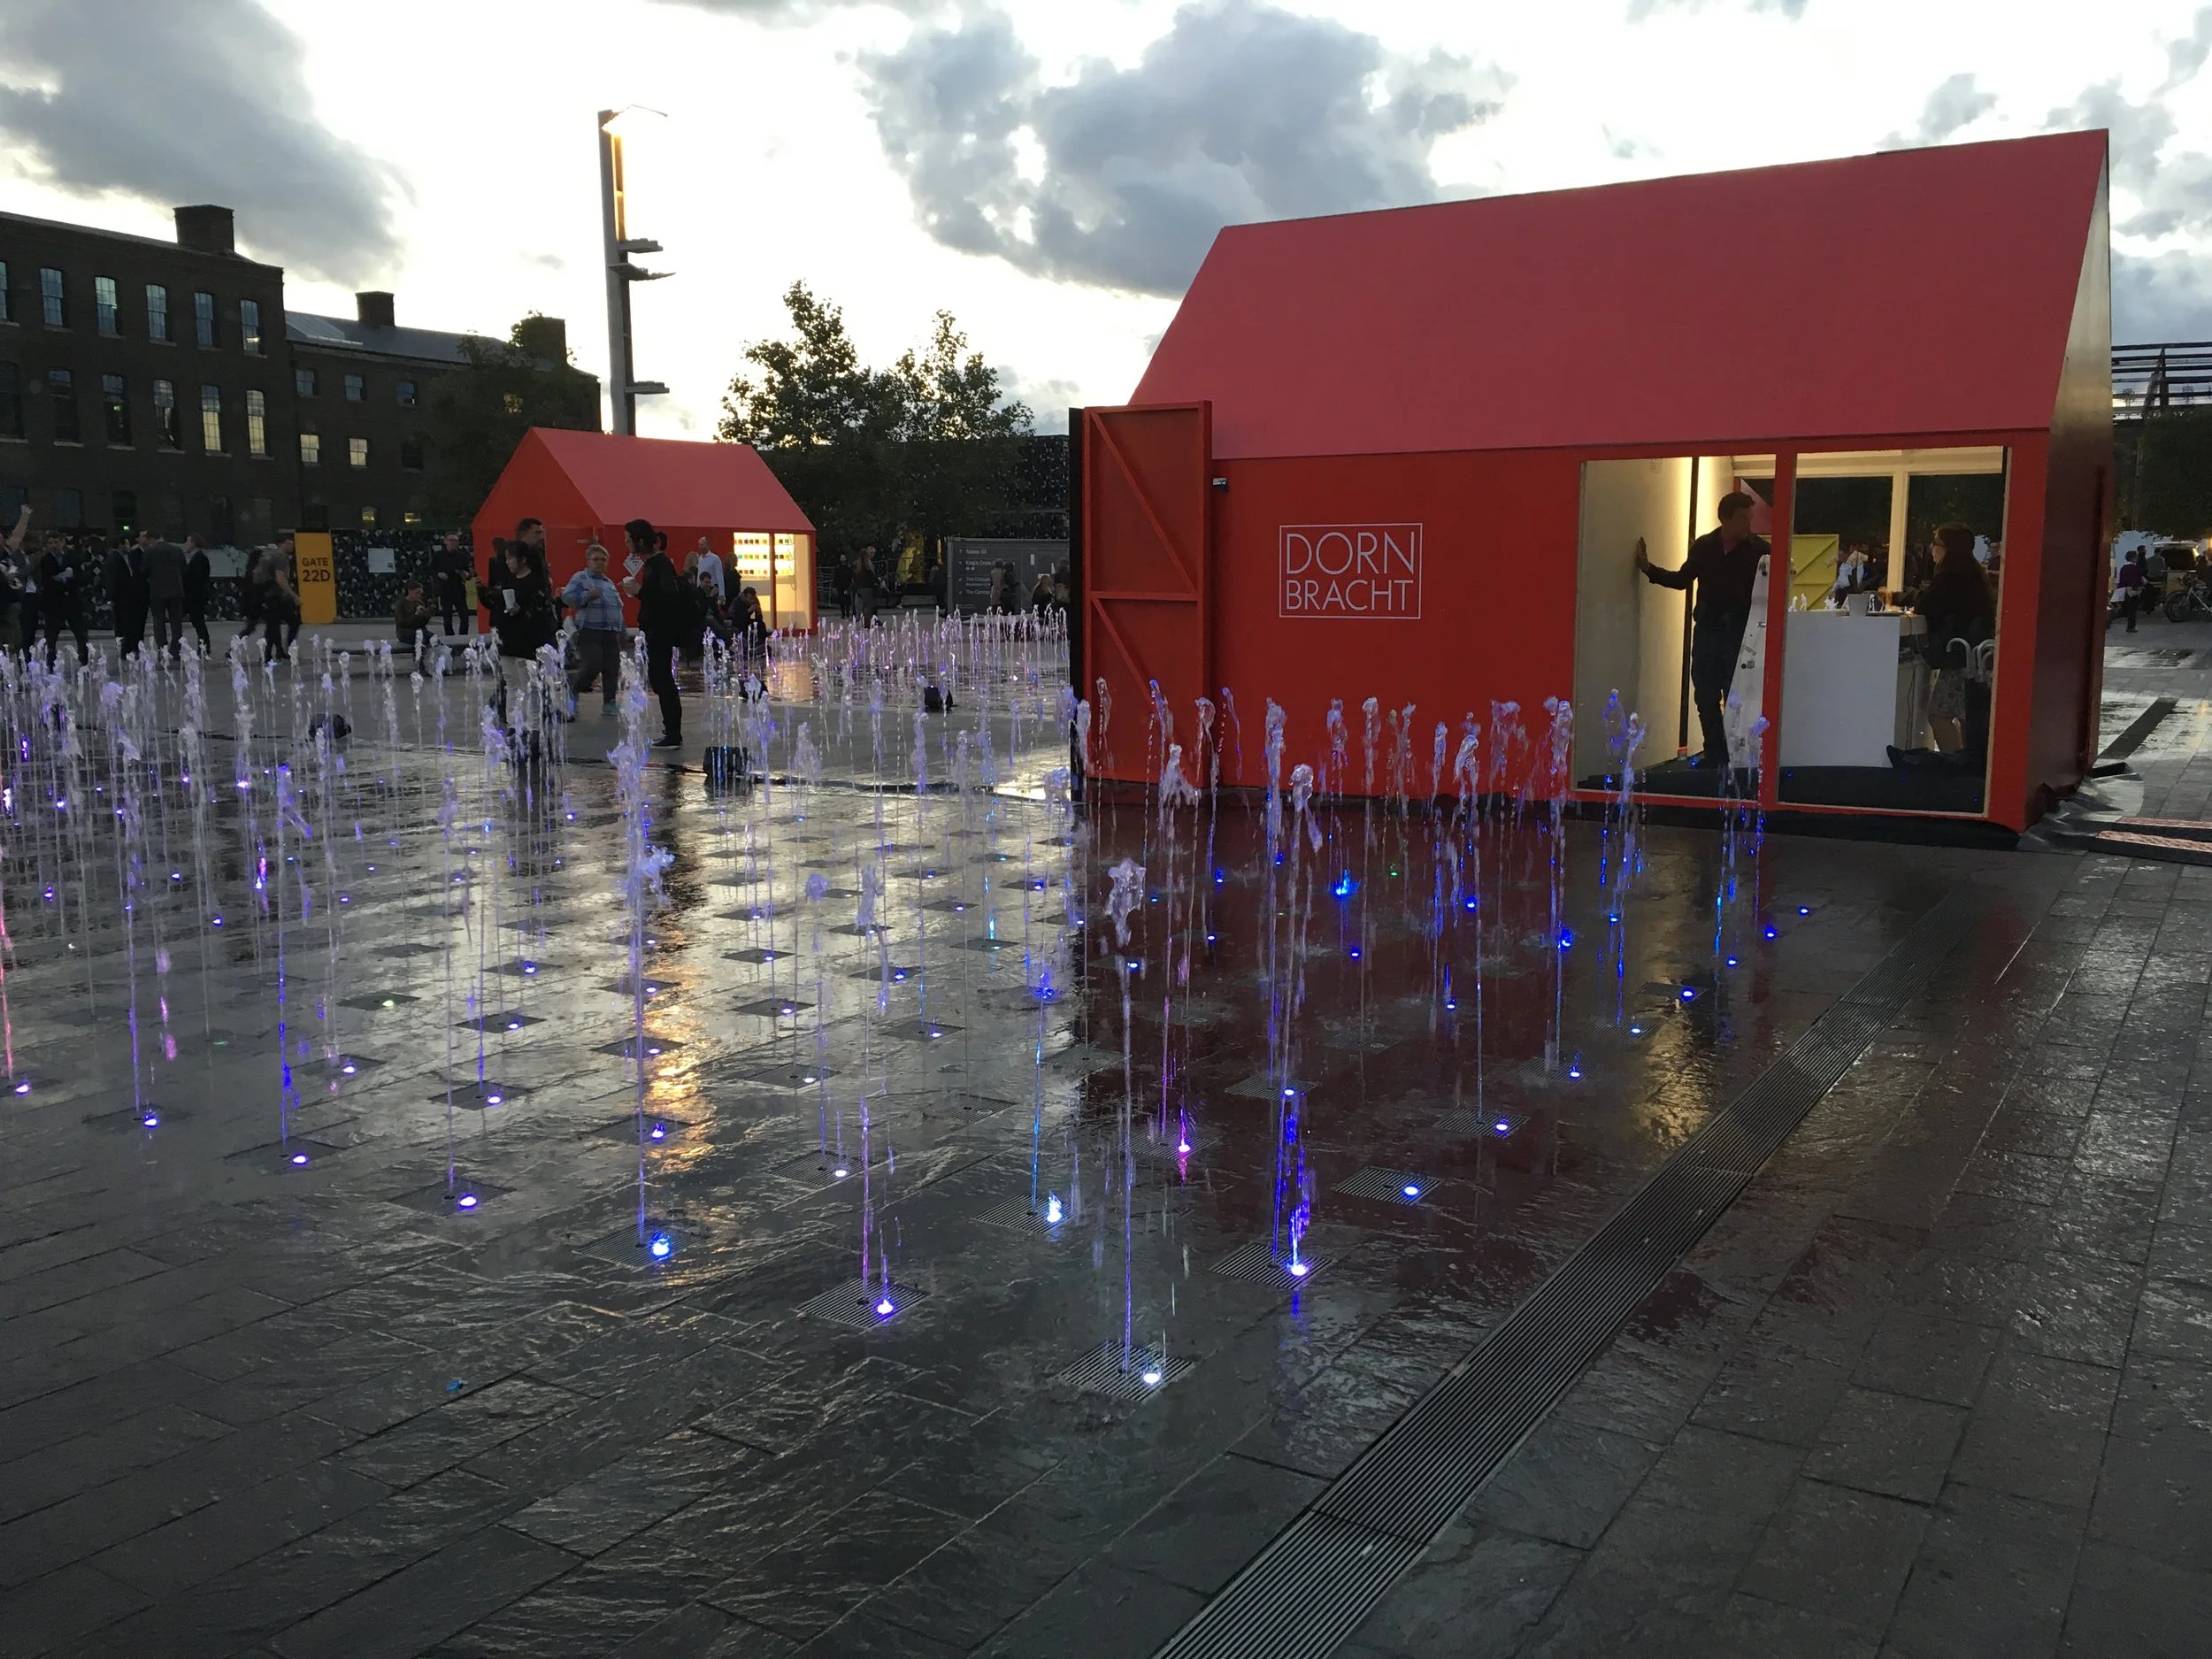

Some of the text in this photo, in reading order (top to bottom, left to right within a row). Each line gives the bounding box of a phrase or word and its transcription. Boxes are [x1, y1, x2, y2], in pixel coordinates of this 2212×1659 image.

[302, 557, 328, 566] GATE
[1286, 532, 1415, 575] DORN
[302, 569, 331, 582] 22D
[1286, 580, 1414, 611] BRACHT
